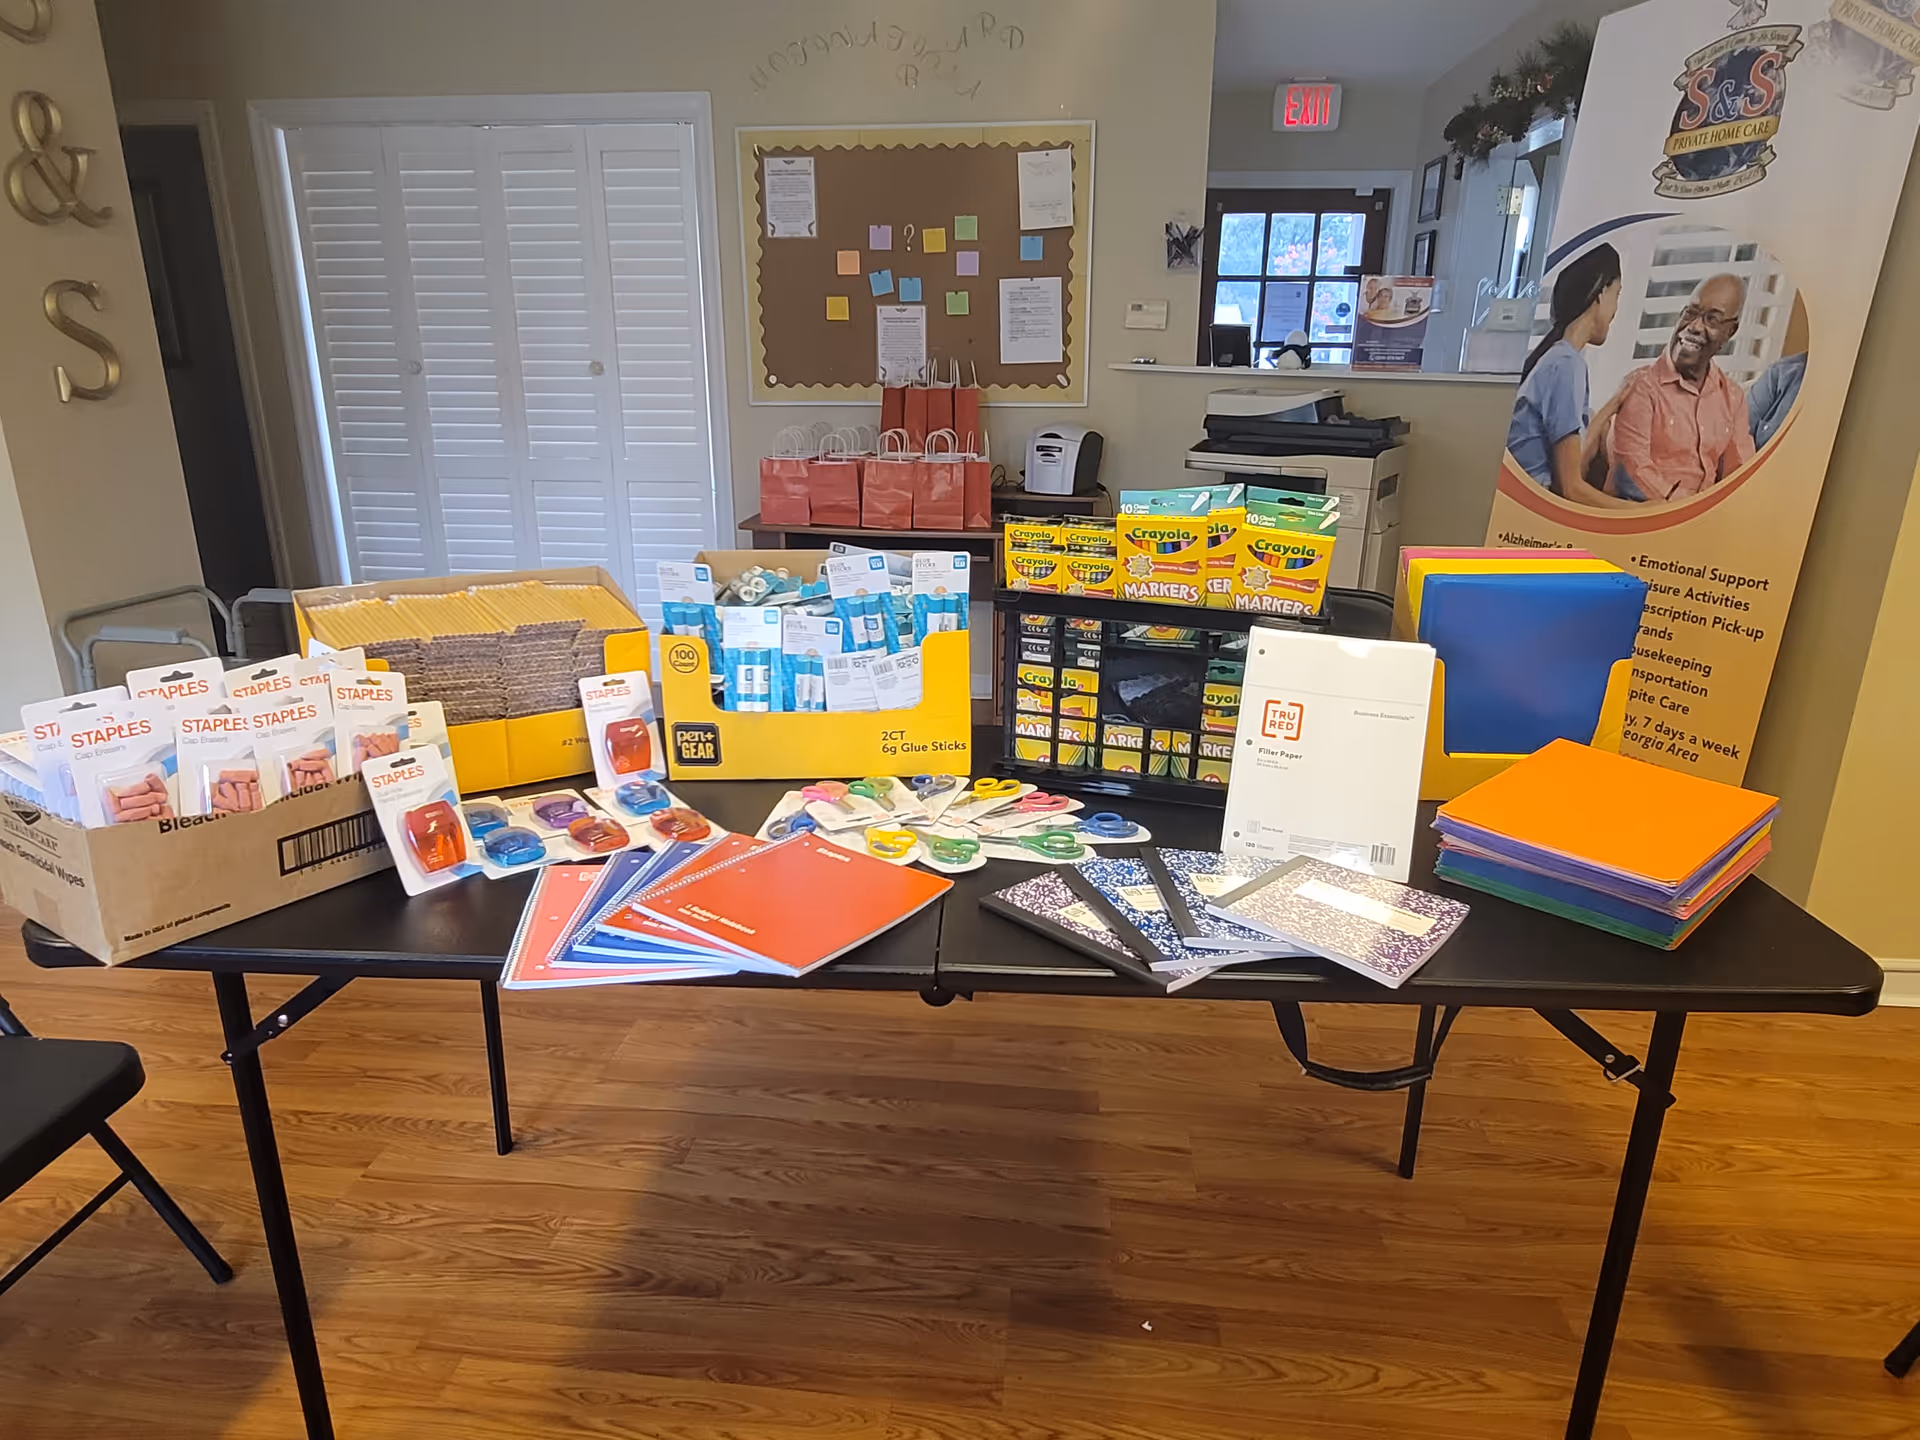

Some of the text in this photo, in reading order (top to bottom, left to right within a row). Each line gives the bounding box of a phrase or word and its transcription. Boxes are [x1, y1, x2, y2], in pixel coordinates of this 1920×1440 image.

[1284, 85, 1334, 126] EXIT
[1673, 121, 1770, 150] PRIVATE HOME CARE
[43, 279, 121, 404] S
[1120, 503, 1133, 514] 10
[1246, 513, 1259, 524] 10
[1013, 529, 1051, 539] Crayola
[1069, 533, 1108, 545] Crayola
[1132, 527, 1190, 543] Crayola
[1255, 539, 1316, 557] Crayola
[1015, 556, 1054, 566] Crayola
[1071, 561, 1110, 571] Crayola
[1639, 555, 1769, 591] Emotional Support
[1124, 582, 1199, 602] MARKERS
[1643, 579, 1750, 612] eisure Activities
[1643, 604, 1764, 642] escription Pick-up
[1638, 625, 1674, 641] rands
[674, 650, 695, 660] 100
[1631, 646, 1712, 678] ousekeeping
[300, 673, 329, 686] STAP
[1632, 668, 1708, 697] nsportation
[337, 687, 393, 701] STAPLES
[586, 686, 631, 700] STAPLES
[1629, 688, 1690, 715] pite Care
[253, 705, 317, 728] STAPLES
[1271, 709, 1296, 721] TRU
[182, 718, 248, 733] STAPLES
[1269, 720, 1294, 730] RED
[71, 719, 151, 748] STAPLES
[882, 730, 906, 741] 2CT
[1624, 713, 1740, 759] ay, 7 days a week
[682, 742, 715, 759] GEAR
[882, 741, 967, 755] 6g Glue Sticks
[1258, 747, 1303, 760] Filler Paper
[1623, 729, 1664, 750] eorgia
[1665, 743, 1700, 762] Area
[75, 751, 94, 761] Cap
[371, 765, 425, 788] STAPLES
[55, 864, 85, 888] Wipes
[124, 933, 143, 942] Made
